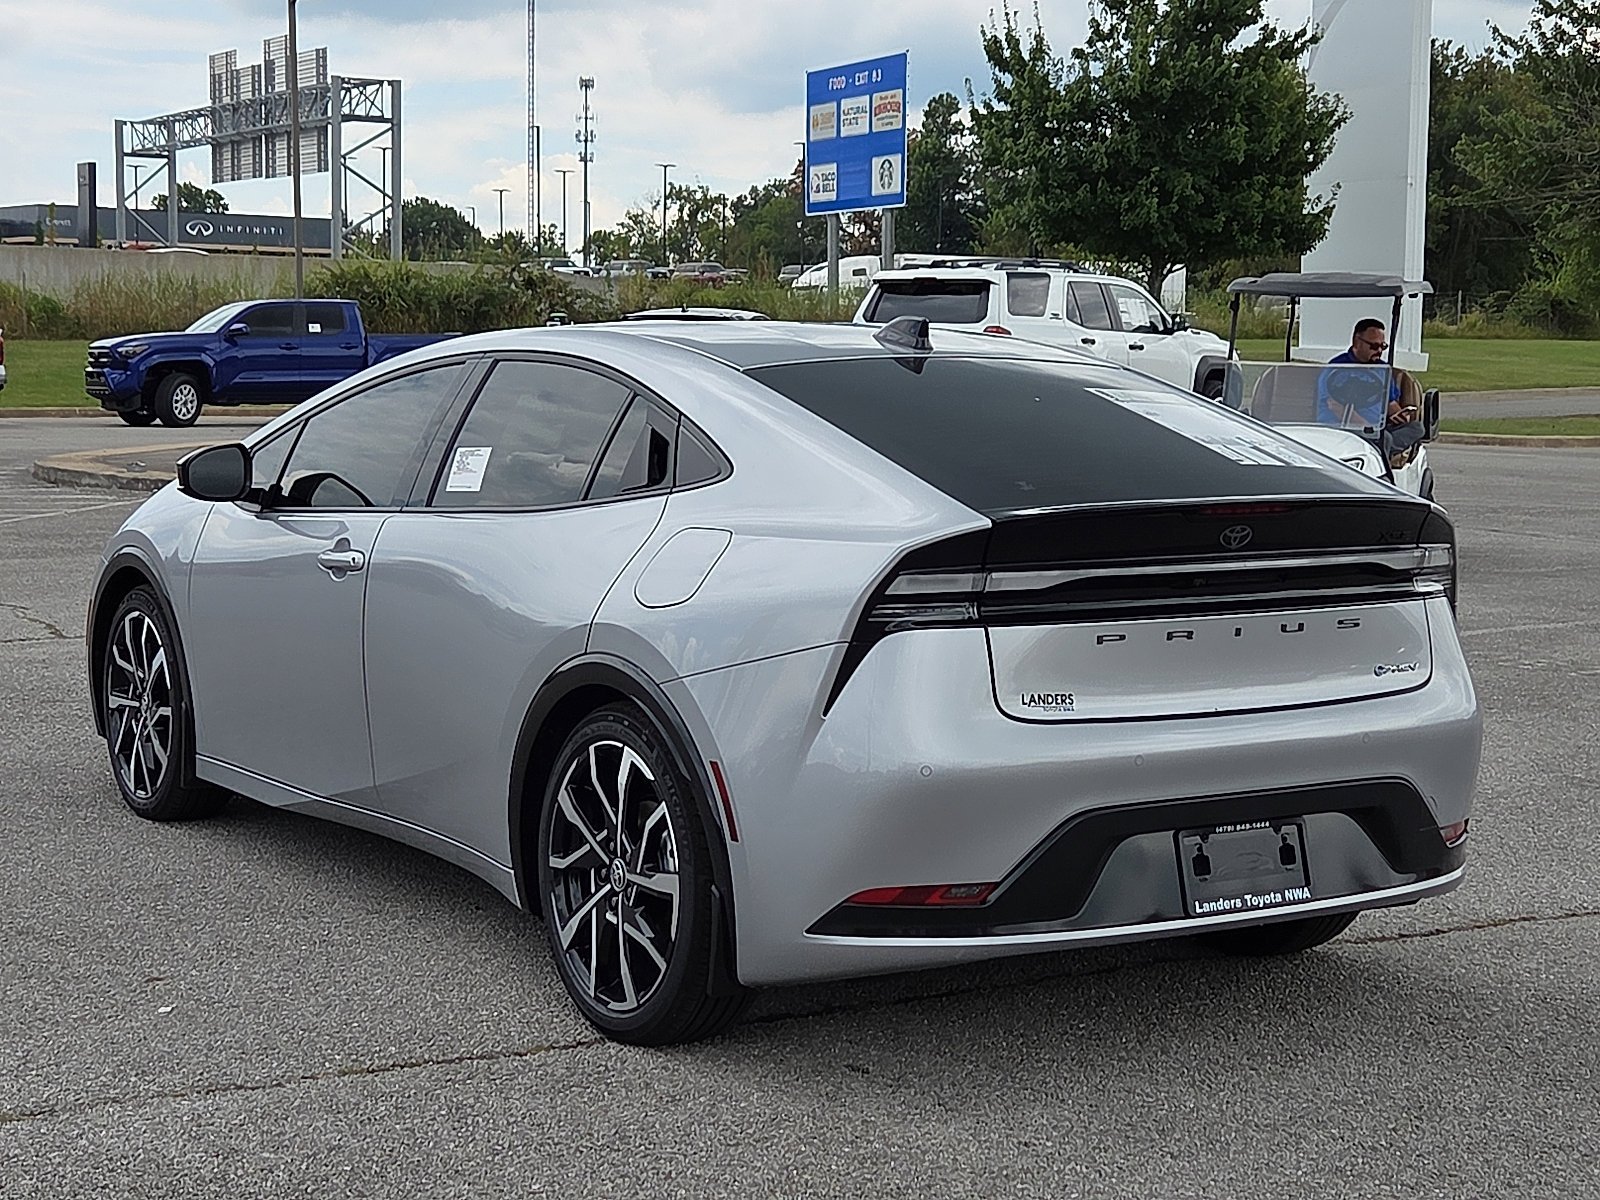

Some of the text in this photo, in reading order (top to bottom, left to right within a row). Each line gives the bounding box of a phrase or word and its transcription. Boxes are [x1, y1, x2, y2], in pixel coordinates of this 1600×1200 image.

[828, 75, 846, 91] FOOD
[855, 70, 869, 86] EXIT
[842, 116, 860, 127] STATE
[821, 172, 836, 183] TACO
[821, 182, 836, 194] BELL
[219, 224, 283, 235] INFINITI
[1096, 618, 1362, 645] PRIUS
[1021, 693, 1075, 707] LANDERS
[1194, 886, 1312, 914] Landers Toyota NWA
